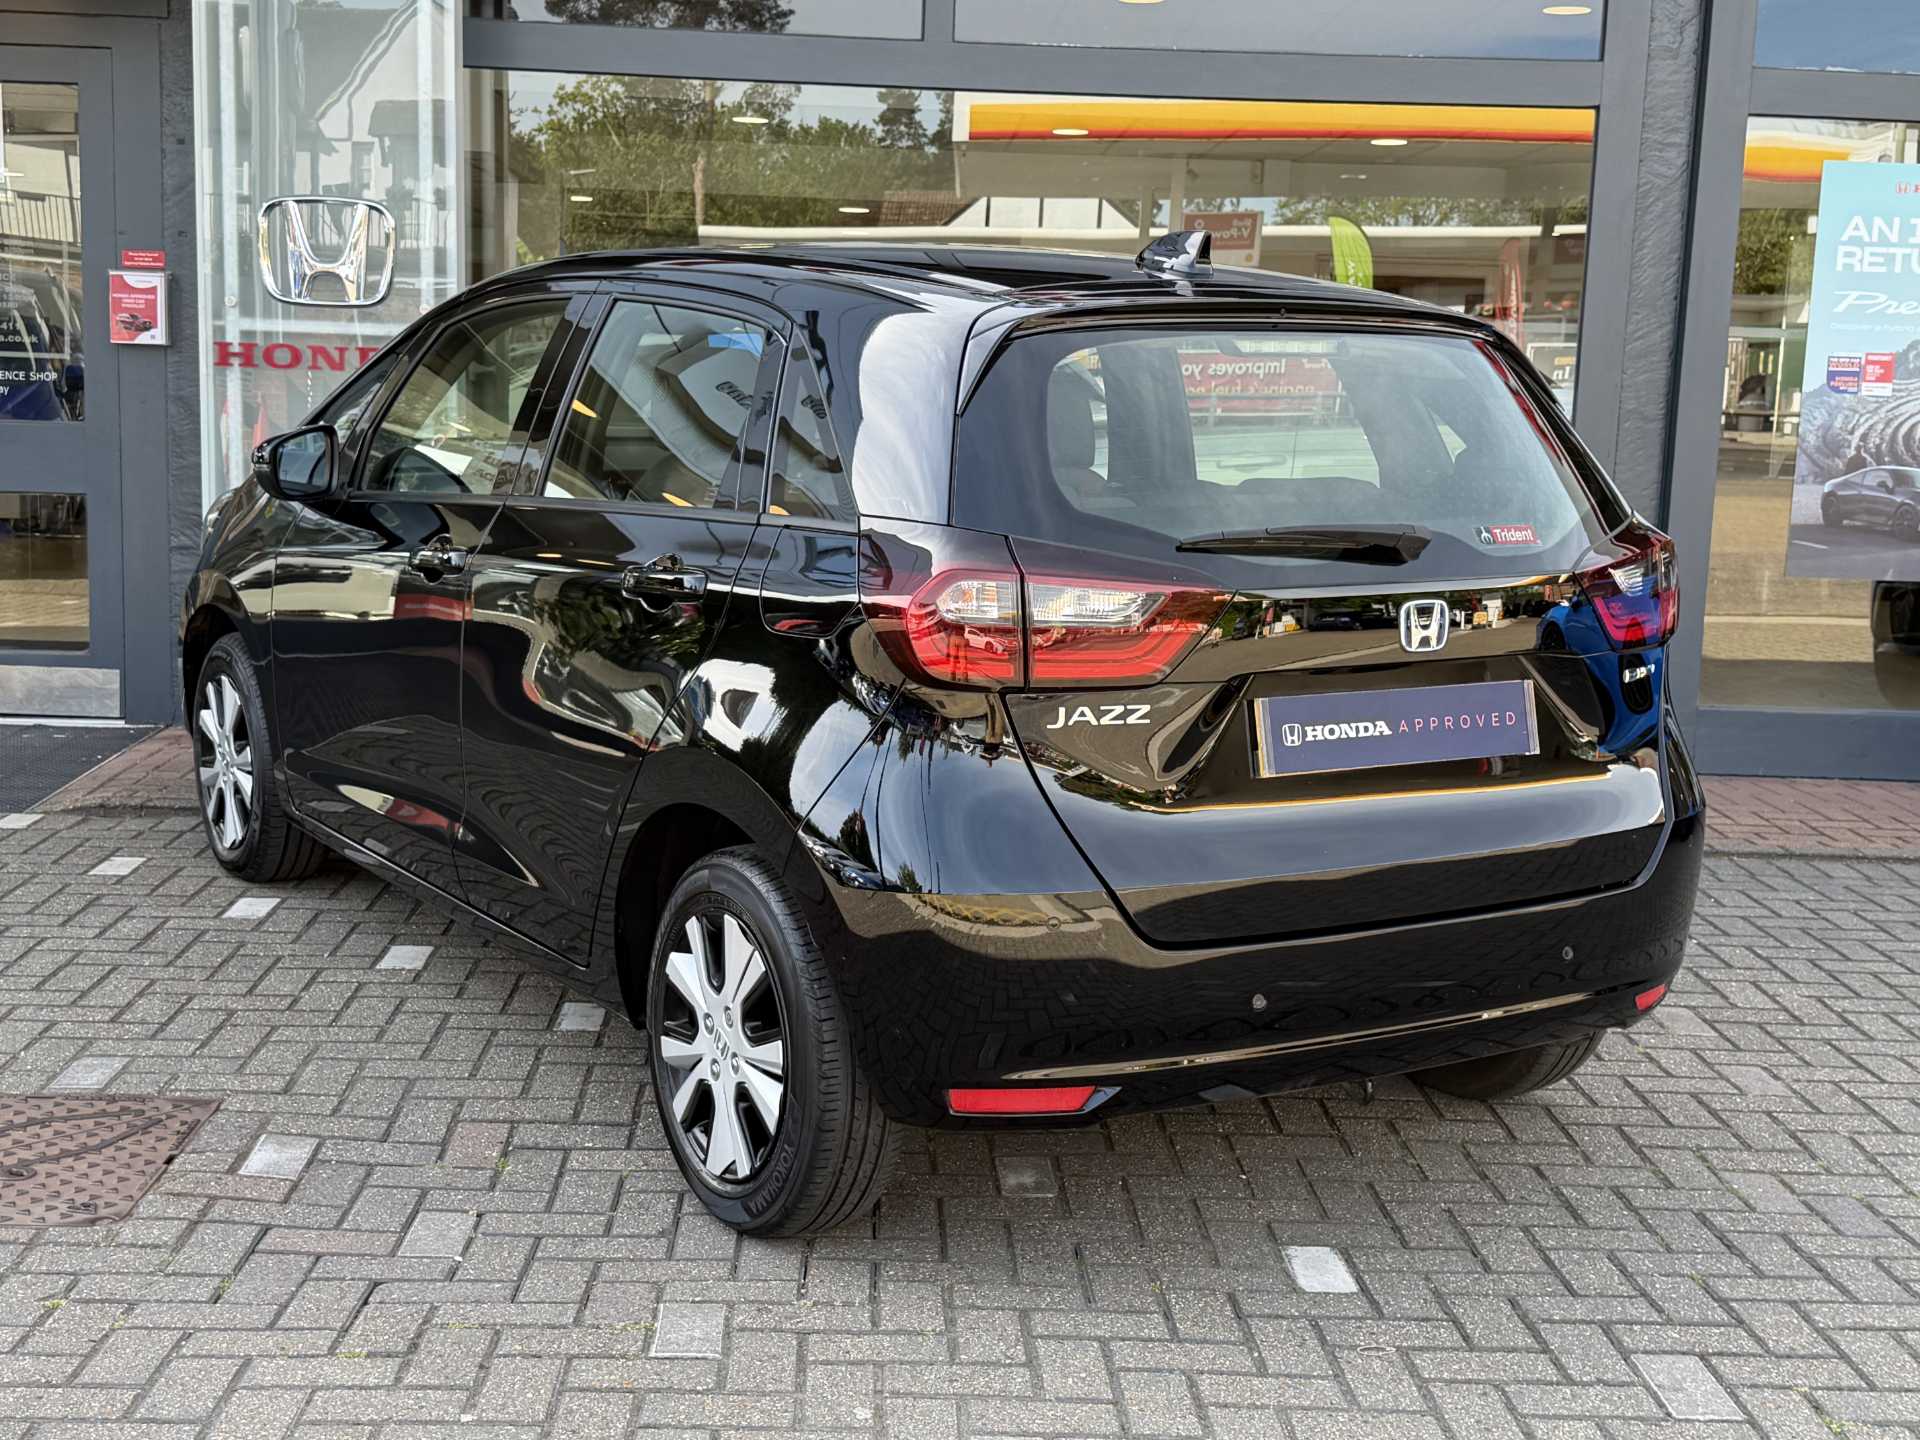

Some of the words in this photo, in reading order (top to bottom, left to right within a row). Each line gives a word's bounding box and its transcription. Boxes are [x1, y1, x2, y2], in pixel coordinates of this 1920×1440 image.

[1839, 215, 1901, 243] AN
[29, 371, 58, 382] SHOP
[1492, 527, 1534, 542] Trident
[1046, 704, 1151, 729] JAZZ
[1304, 720, 1393, 743] HONDA
[1399, 711, 1517, 734] APPROVED
[745, 1142, 797, 1217] YOKOHAMA
